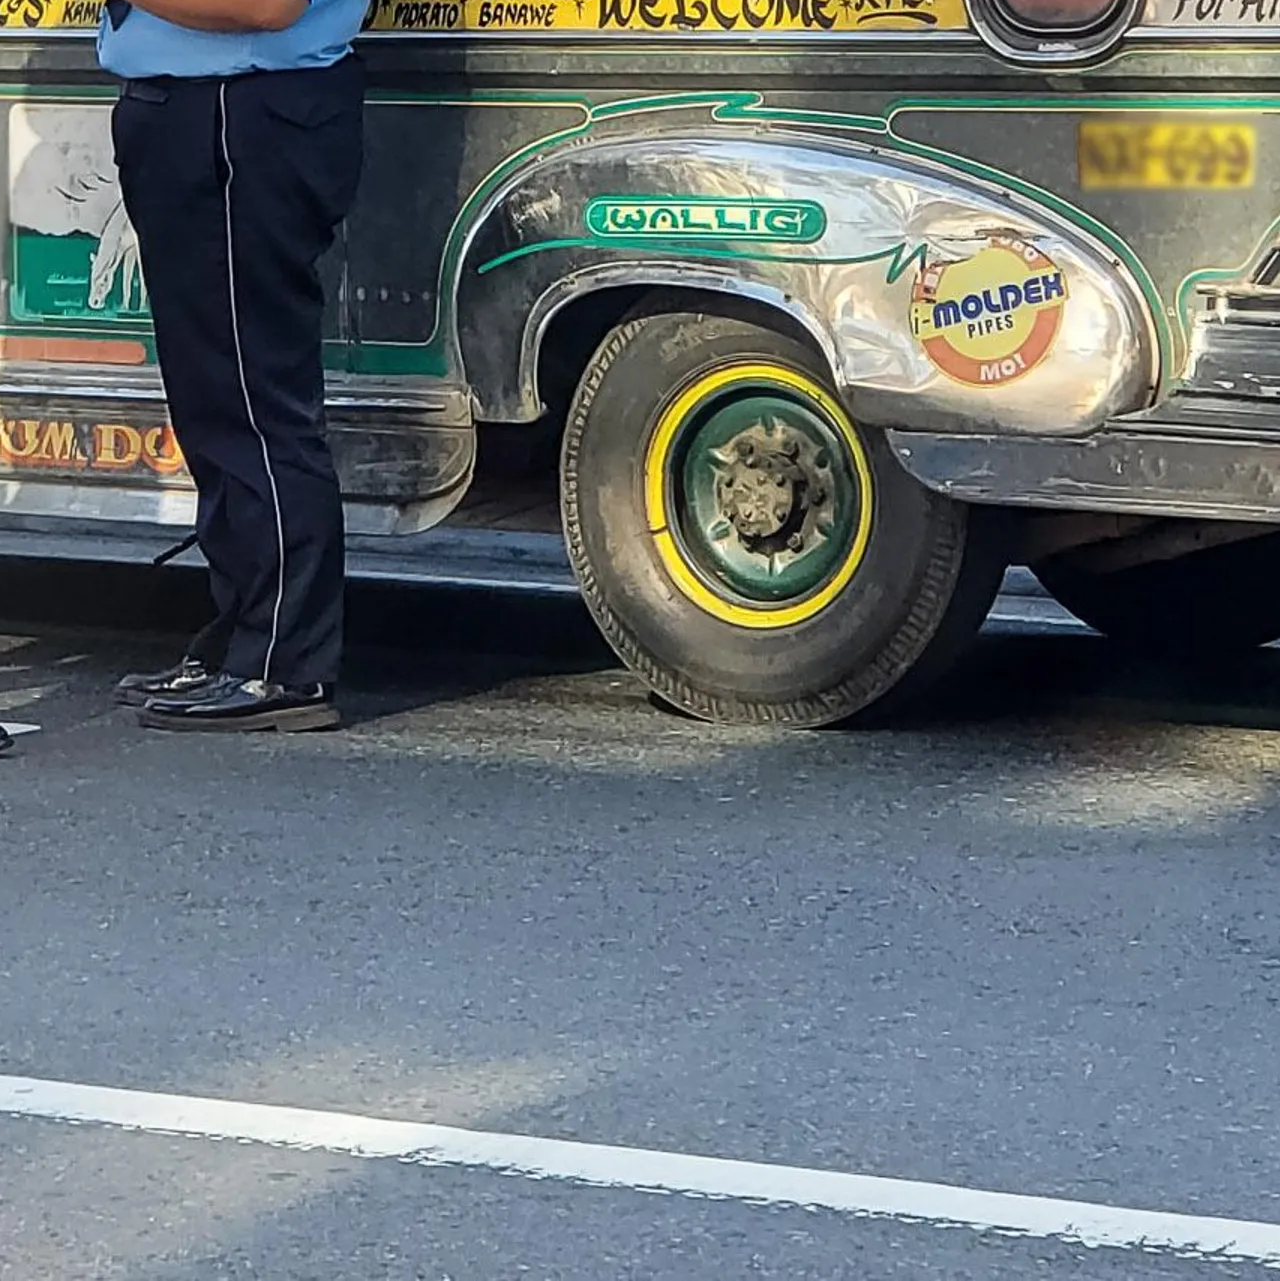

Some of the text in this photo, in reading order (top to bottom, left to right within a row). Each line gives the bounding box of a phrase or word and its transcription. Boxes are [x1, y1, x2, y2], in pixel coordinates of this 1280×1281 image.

[383, 2, 459, 29] MORATO
[477, 3, 557, 28] BANAWE
[967, 313, 1014, 339] PIPES
